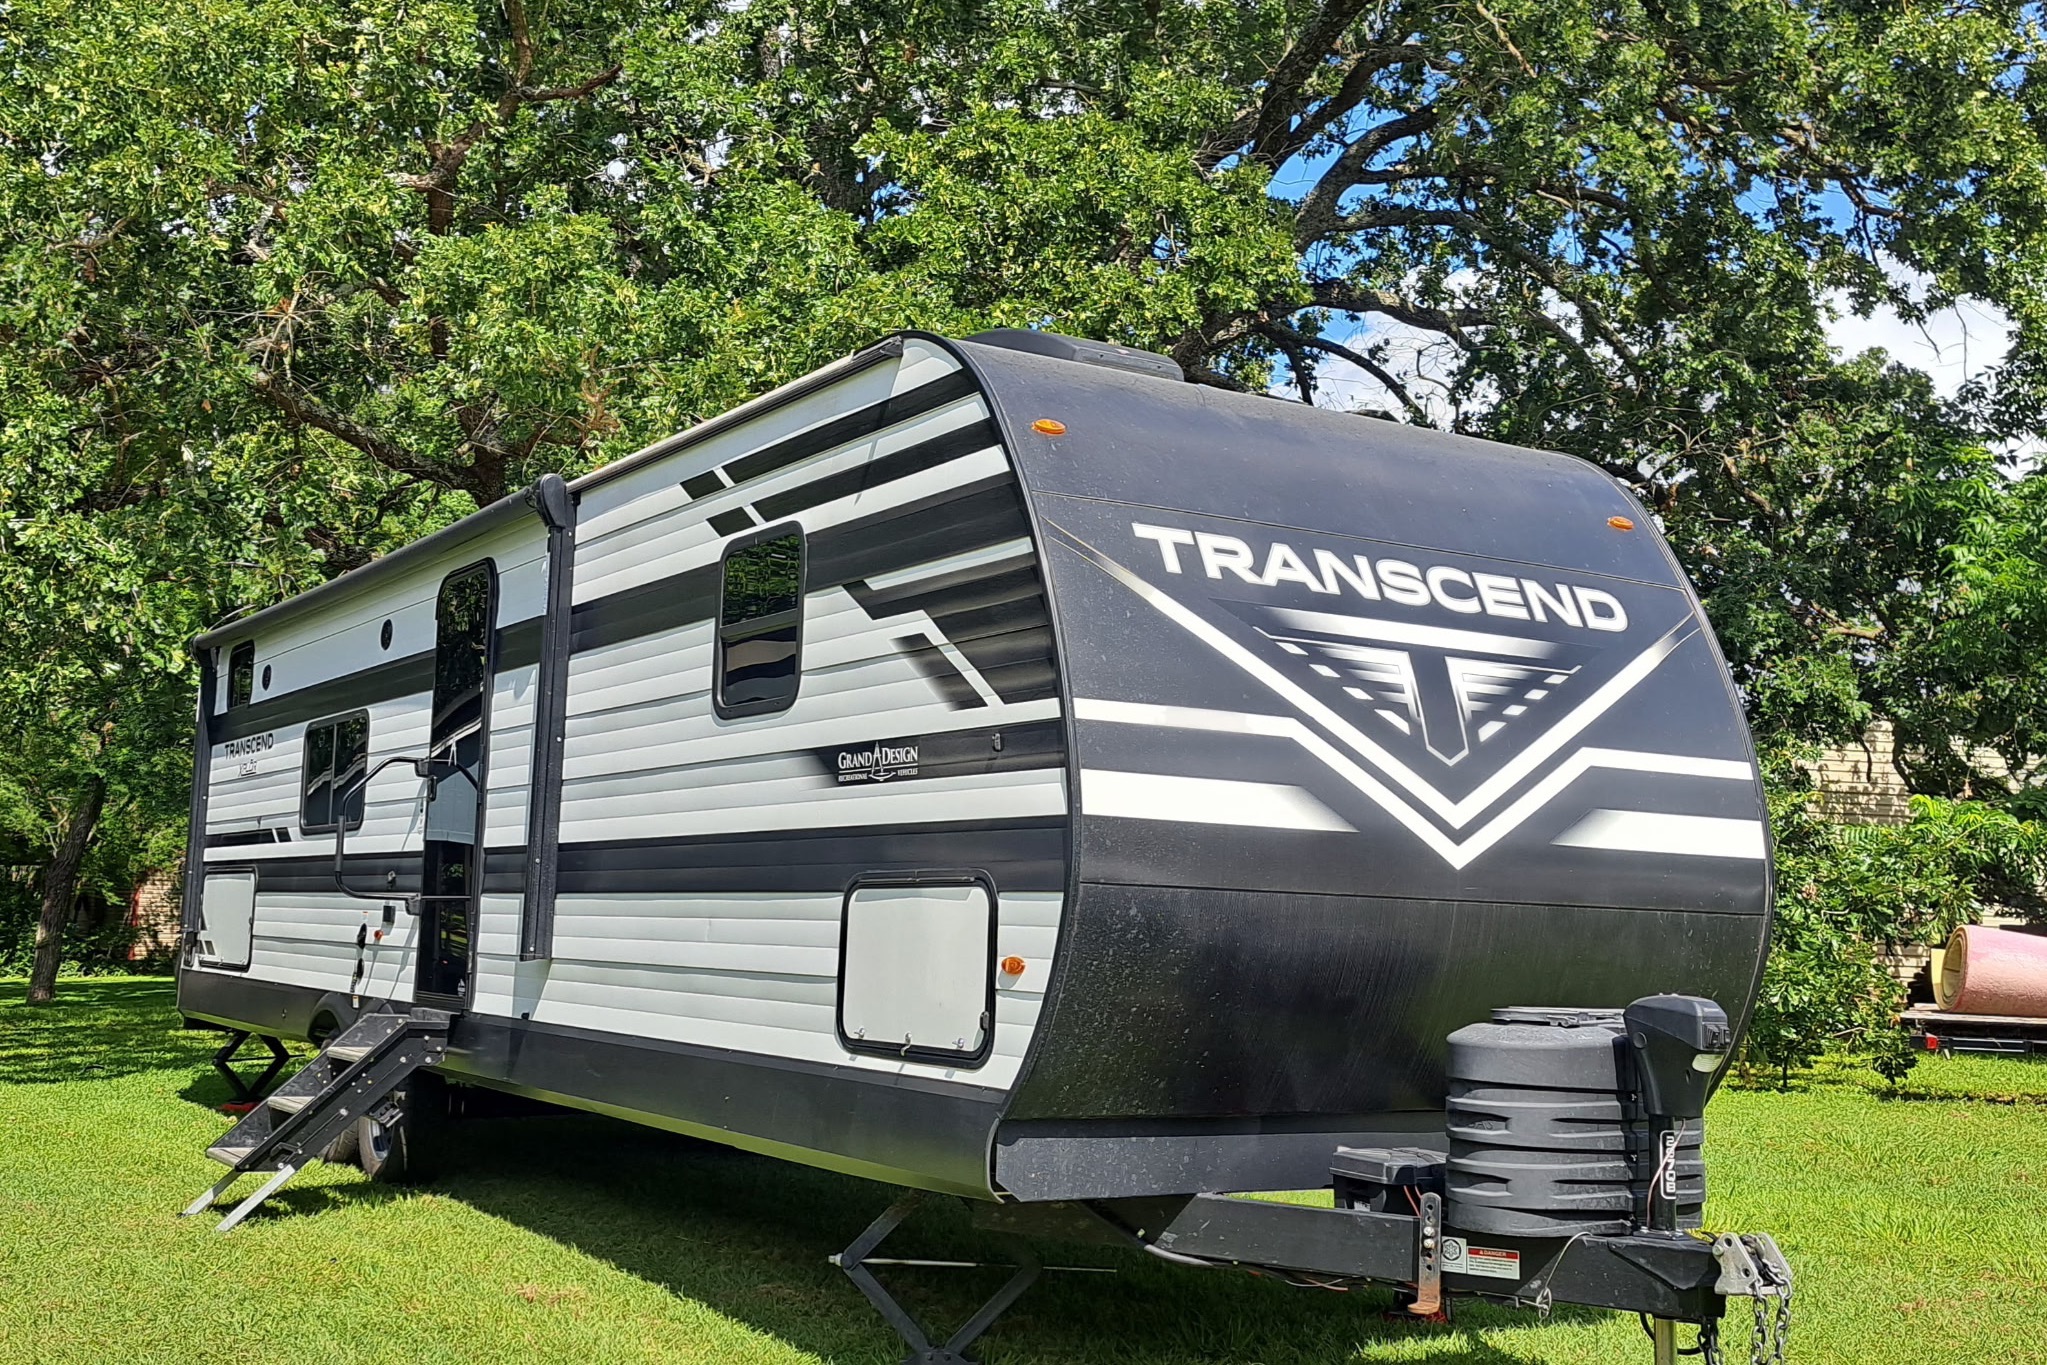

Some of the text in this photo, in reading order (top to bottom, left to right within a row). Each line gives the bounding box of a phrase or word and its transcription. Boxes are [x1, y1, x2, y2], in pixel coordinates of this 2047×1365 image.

[1132, 522, 1629, 632] TRANSCEND
[224, 733, 274, 759] TRANSCEND
[838, 746, 918, 769] GRAND DESIGN
[897, 767, 918, 776] VEHICLES
